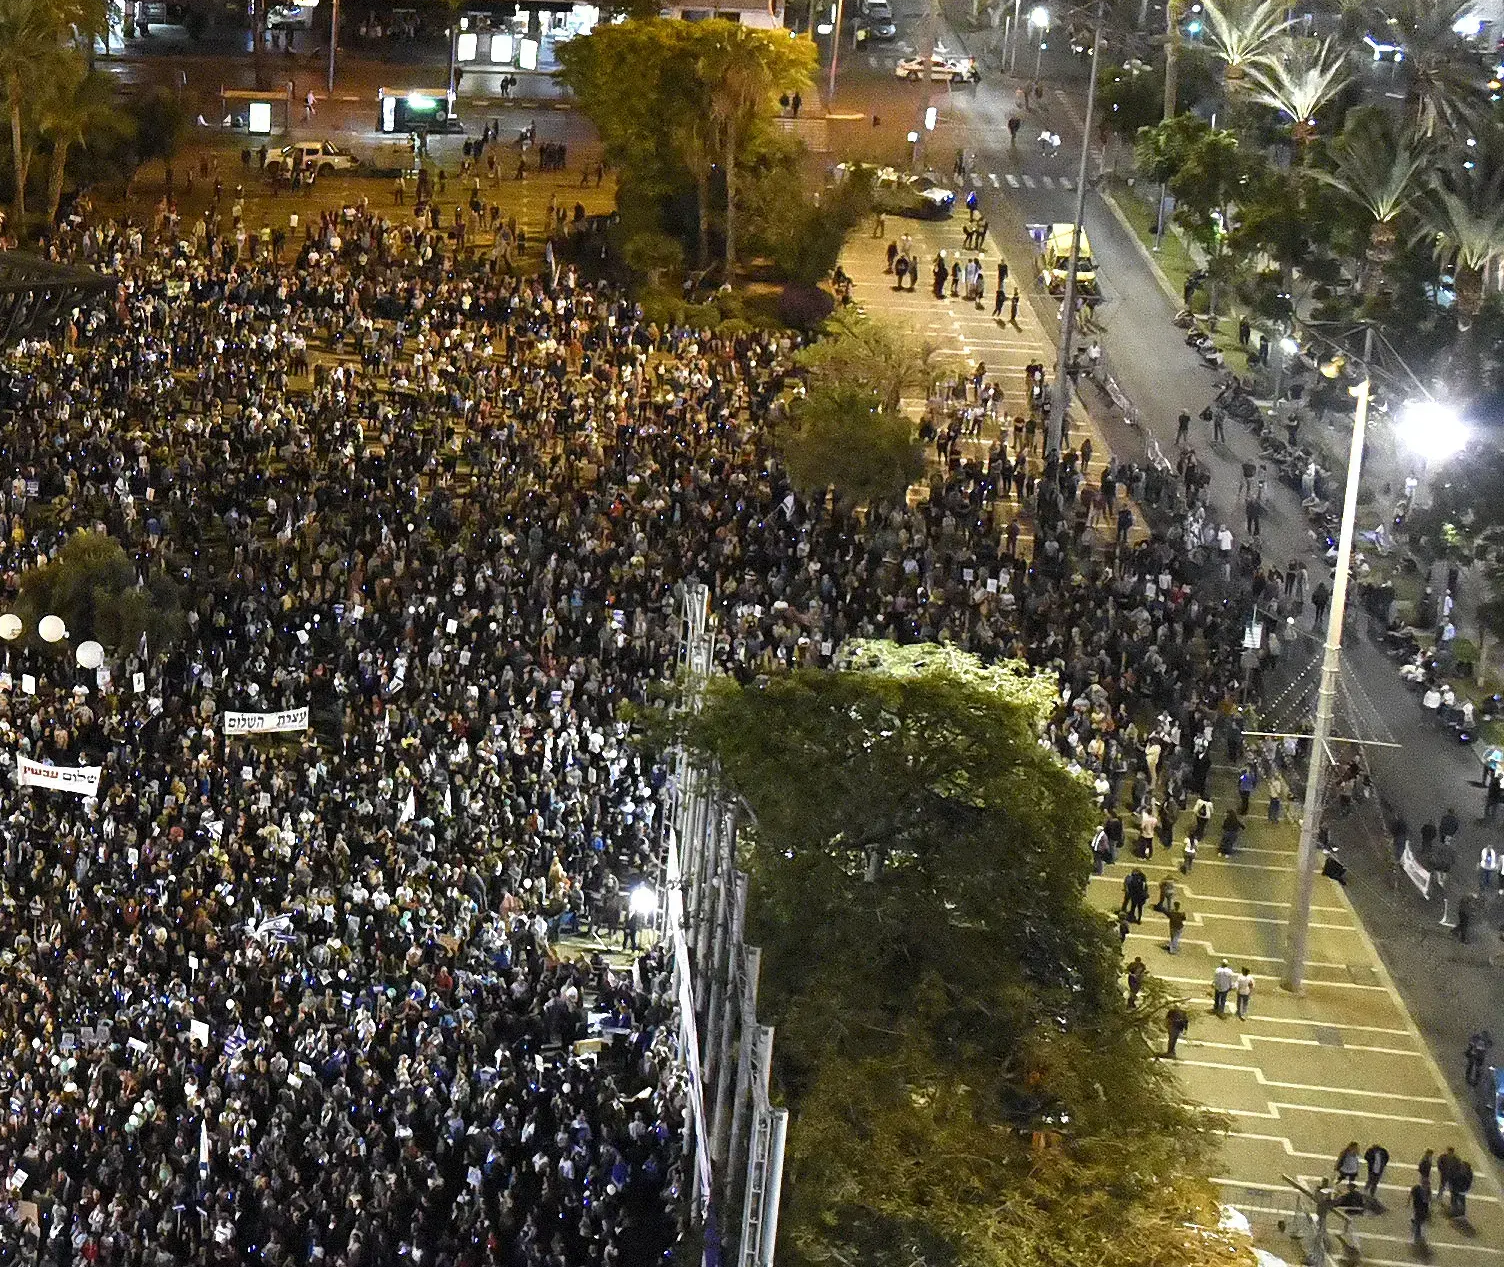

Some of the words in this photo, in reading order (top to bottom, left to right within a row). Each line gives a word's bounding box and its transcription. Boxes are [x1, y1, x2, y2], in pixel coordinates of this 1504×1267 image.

[228, 714, 265, 729] השלום
[276, 711, 307, 727] עצרת
[23, 766, 59, 779] עכשיו
[62, 769, 97, 783] שלום
